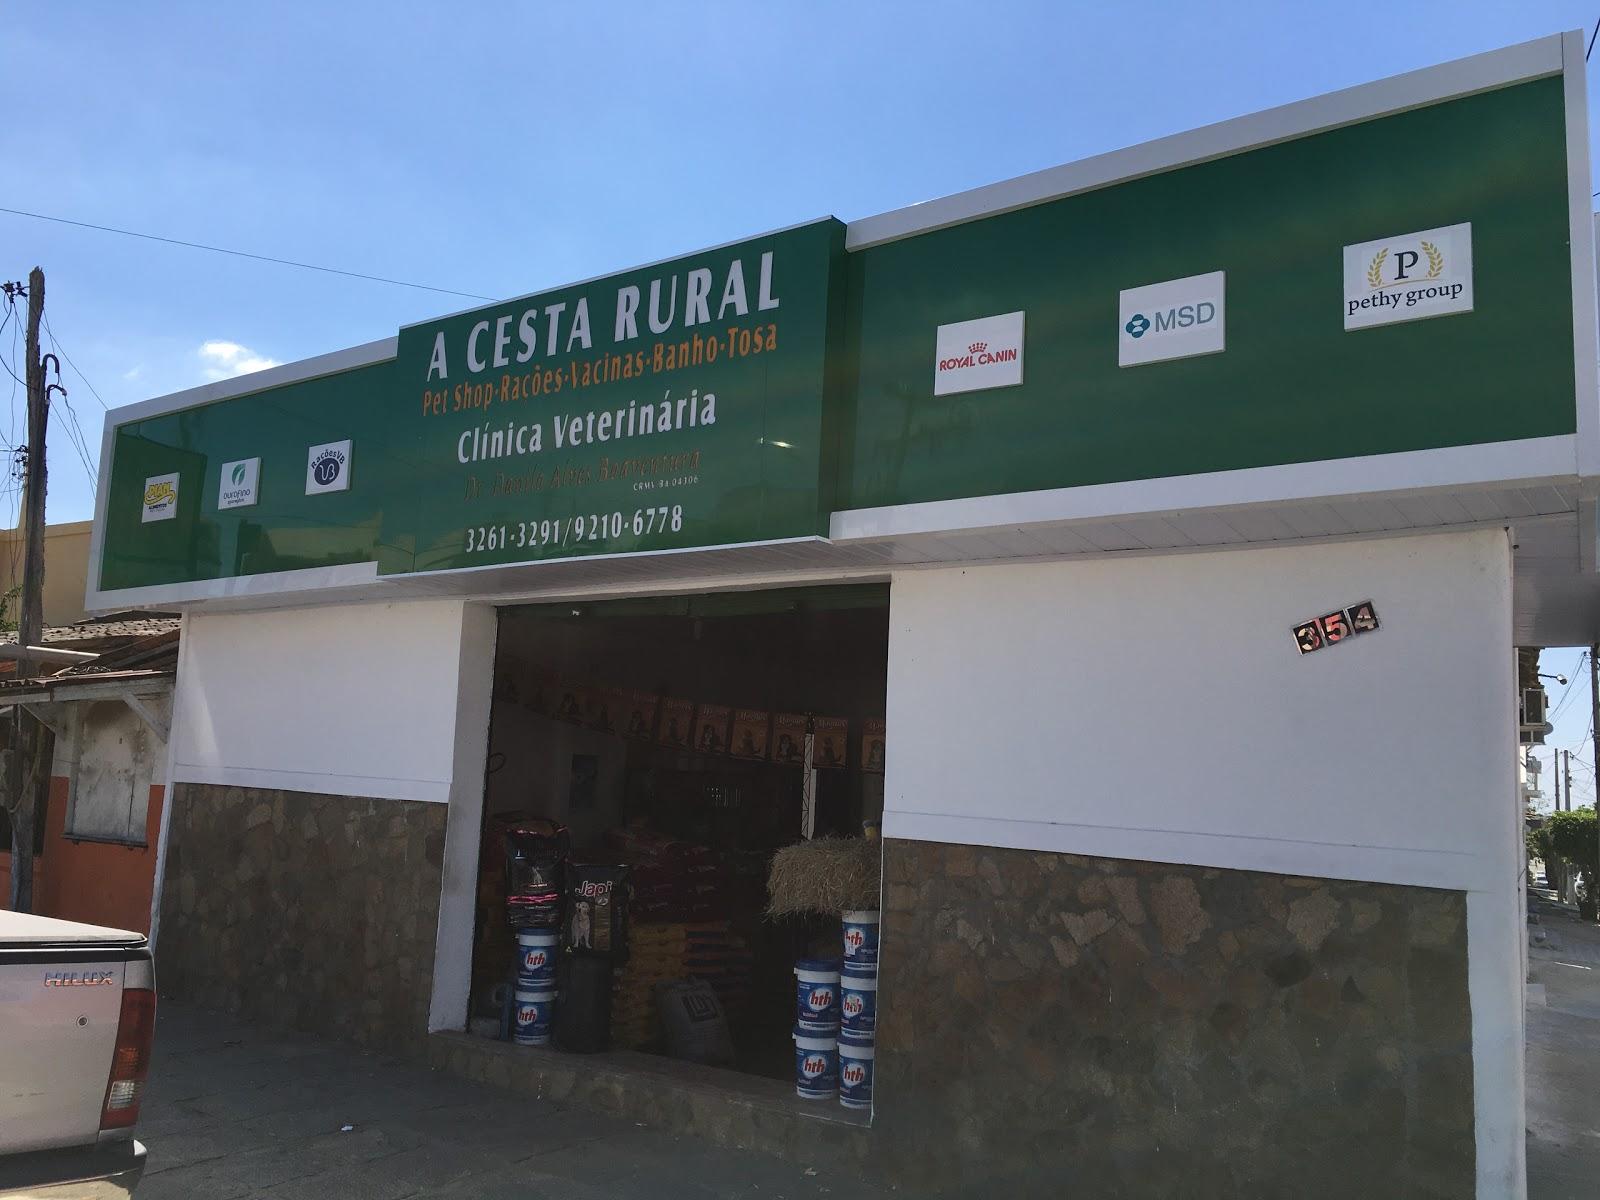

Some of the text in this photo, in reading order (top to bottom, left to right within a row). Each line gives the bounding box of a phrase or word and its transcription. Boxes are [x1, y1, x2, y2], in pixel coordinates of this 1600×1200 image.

[1395, 250, 1418, 280] P
[1348, 283, 1463, 316] pethy group
[427, 251, 780, 382] A CESTA RURAL
[1154, 301, 1216, 333] MSD
[939, 348, 1017, 372] ROYAL CANIN
[423, 388, 449, 416] Pet
[458, 389, 717, 464] Clínica Veterinária
[1297, 606, 1376, 651] 354
[527, 952, 546, 967] hth
[44, 970, 115, 988] HILUX
[811, 990, 832, 1007] hth
[843, 998, 863, 1014] hth
[518, 1009, 537, 1024] hth
[803, 1057, 826, 1074] hth
[844, 1065, 864, 1082] hth
